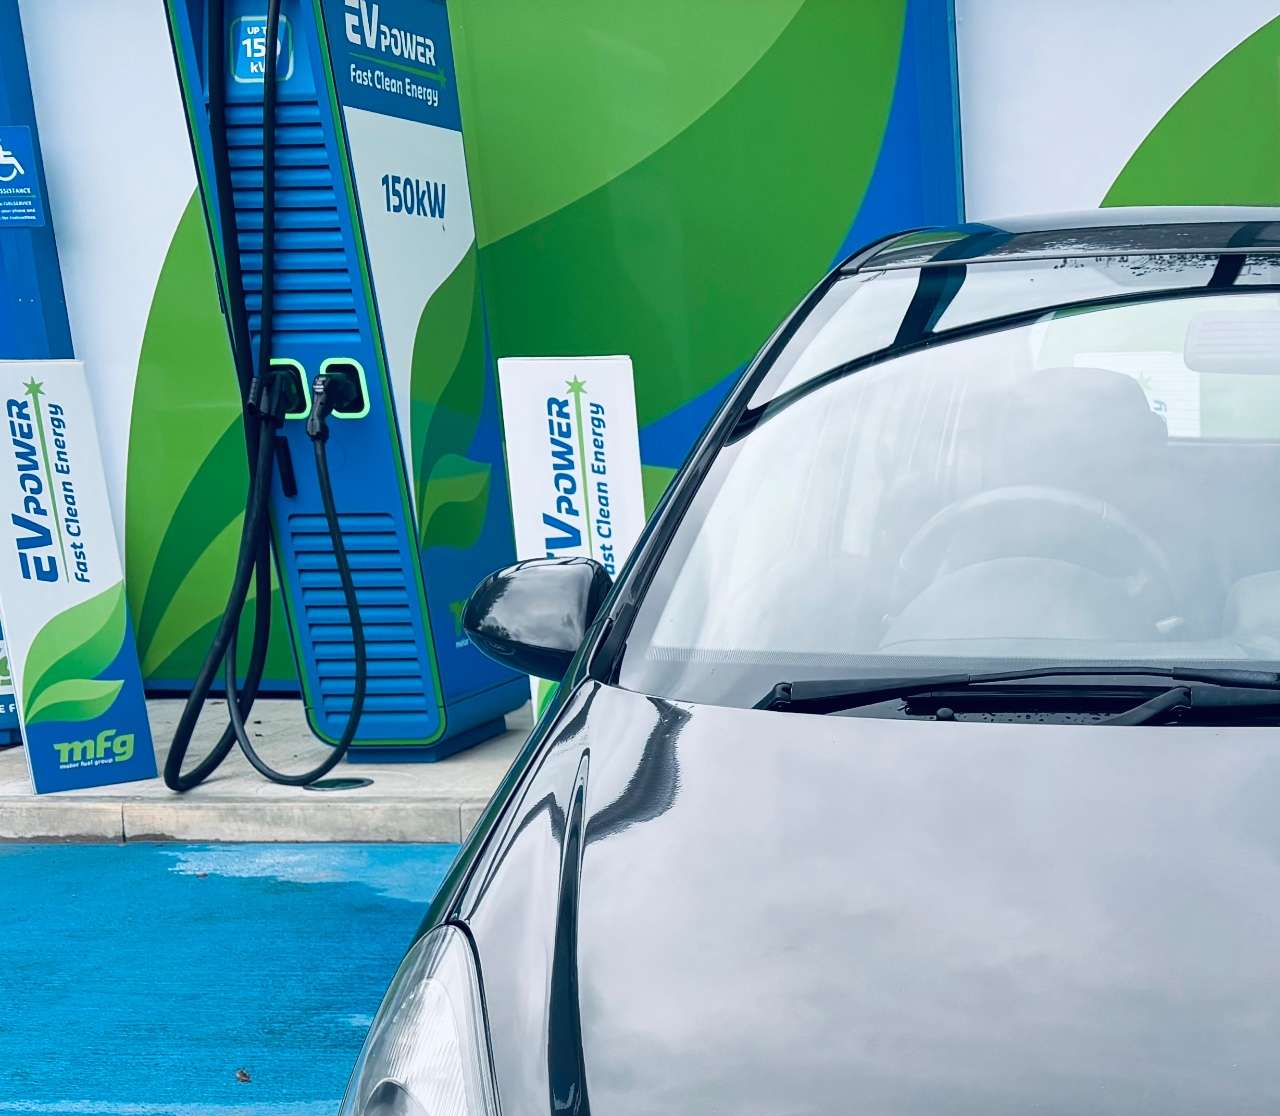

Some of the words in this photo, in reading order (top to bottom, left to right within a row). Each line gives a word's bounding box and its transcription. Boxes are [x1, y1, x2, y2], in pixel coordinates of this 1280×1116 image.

[242, 38, 281, 58] 15
[247, 26, 260, 35] UP
[350, 64, 373, 87] Fast
[374, 72, 403, 94] Clean
[405, 79, 439, 107] Energy
[381, 174, 446, 219] 150kW
[48, 403, 70, 475] Energy
[590, 402, 607, 475] Energy
[62, 481, 81, 537] Clean
[596, 481, 612, 539] Clean
[69, 542, 91, 583] Fast
[599, 544, 615, 576] ast
[53, 729, 135, 762] mfg
